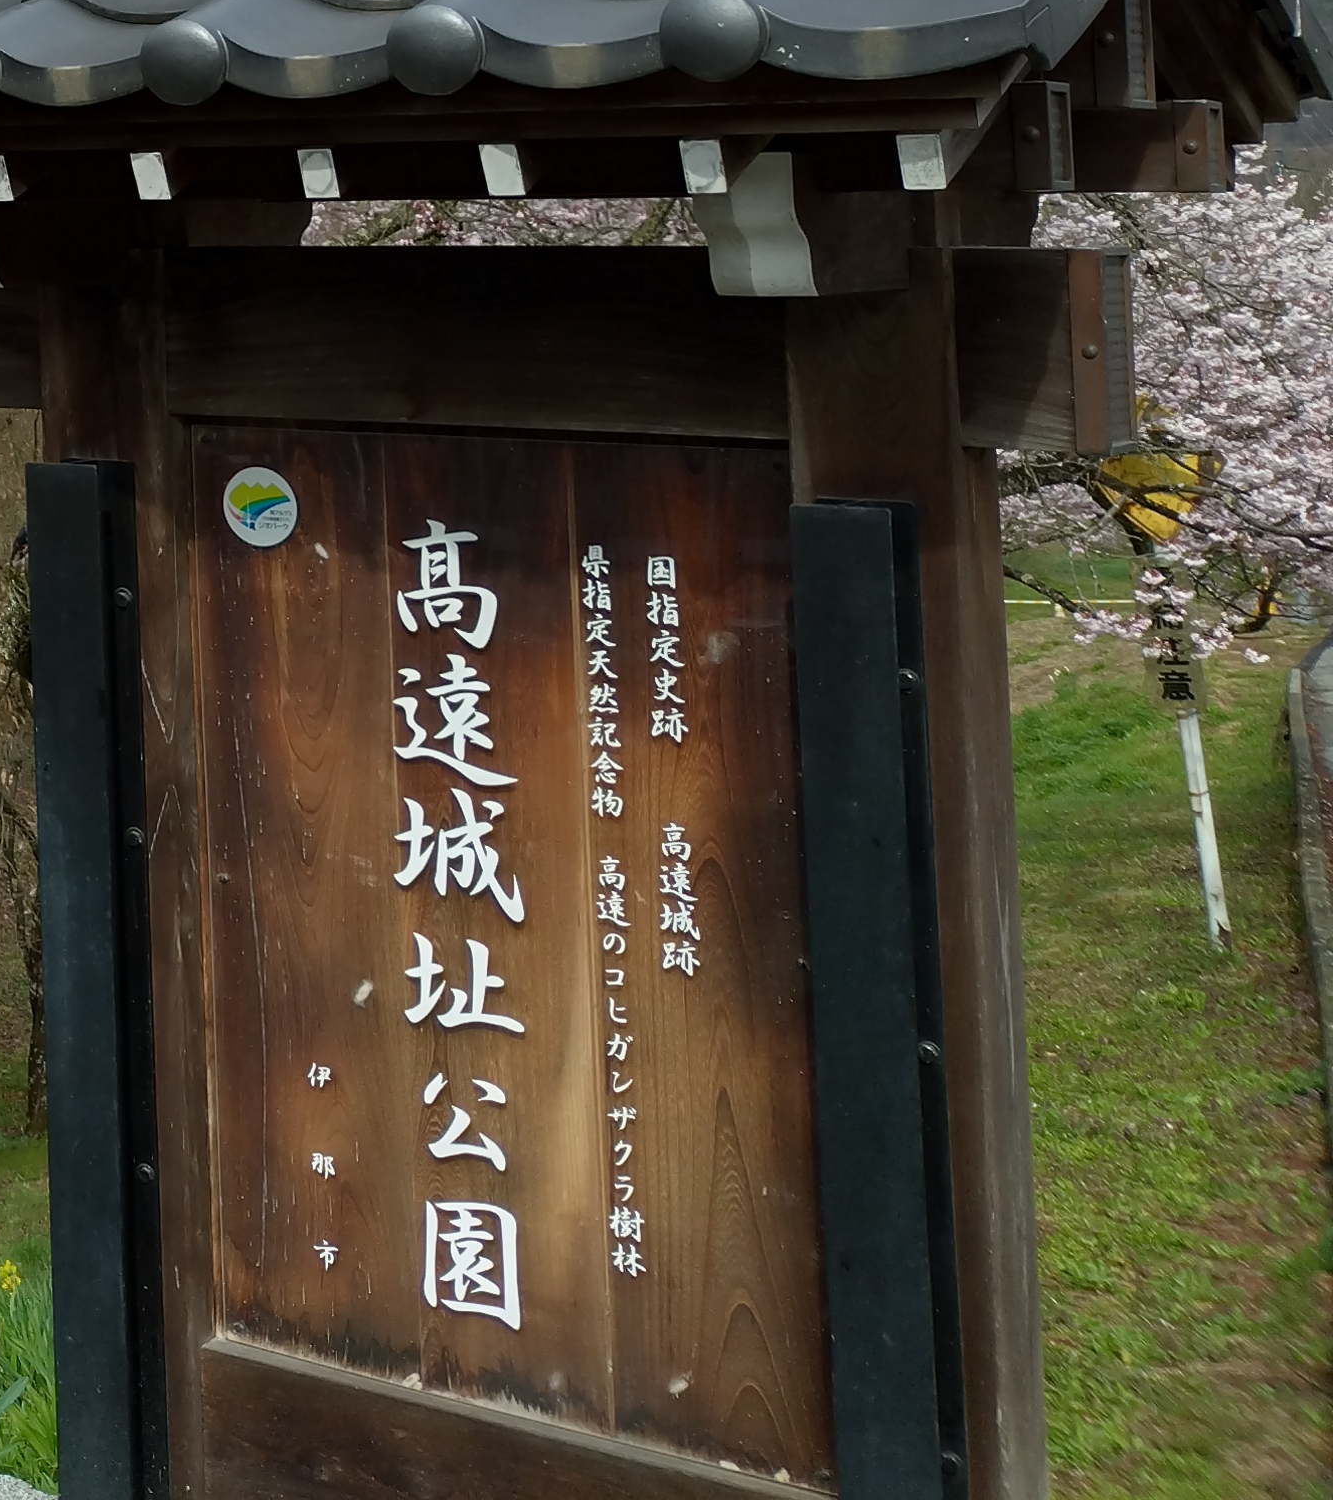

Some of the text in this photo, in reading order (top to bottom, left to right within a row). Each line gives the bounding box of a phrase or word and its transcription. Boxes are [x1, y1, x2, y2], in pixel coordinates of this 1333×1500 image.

[581, 544, 625, 818] 県指定天然記念物
[646, 555, 689, 743] 国指定史跡
[659, 822, 701, 977] 高遠城跡
[307, 1062, 339, 1272] 伊那市
[595, 855, 647, 1278] 高遠のコヒガンザクラ樹林
